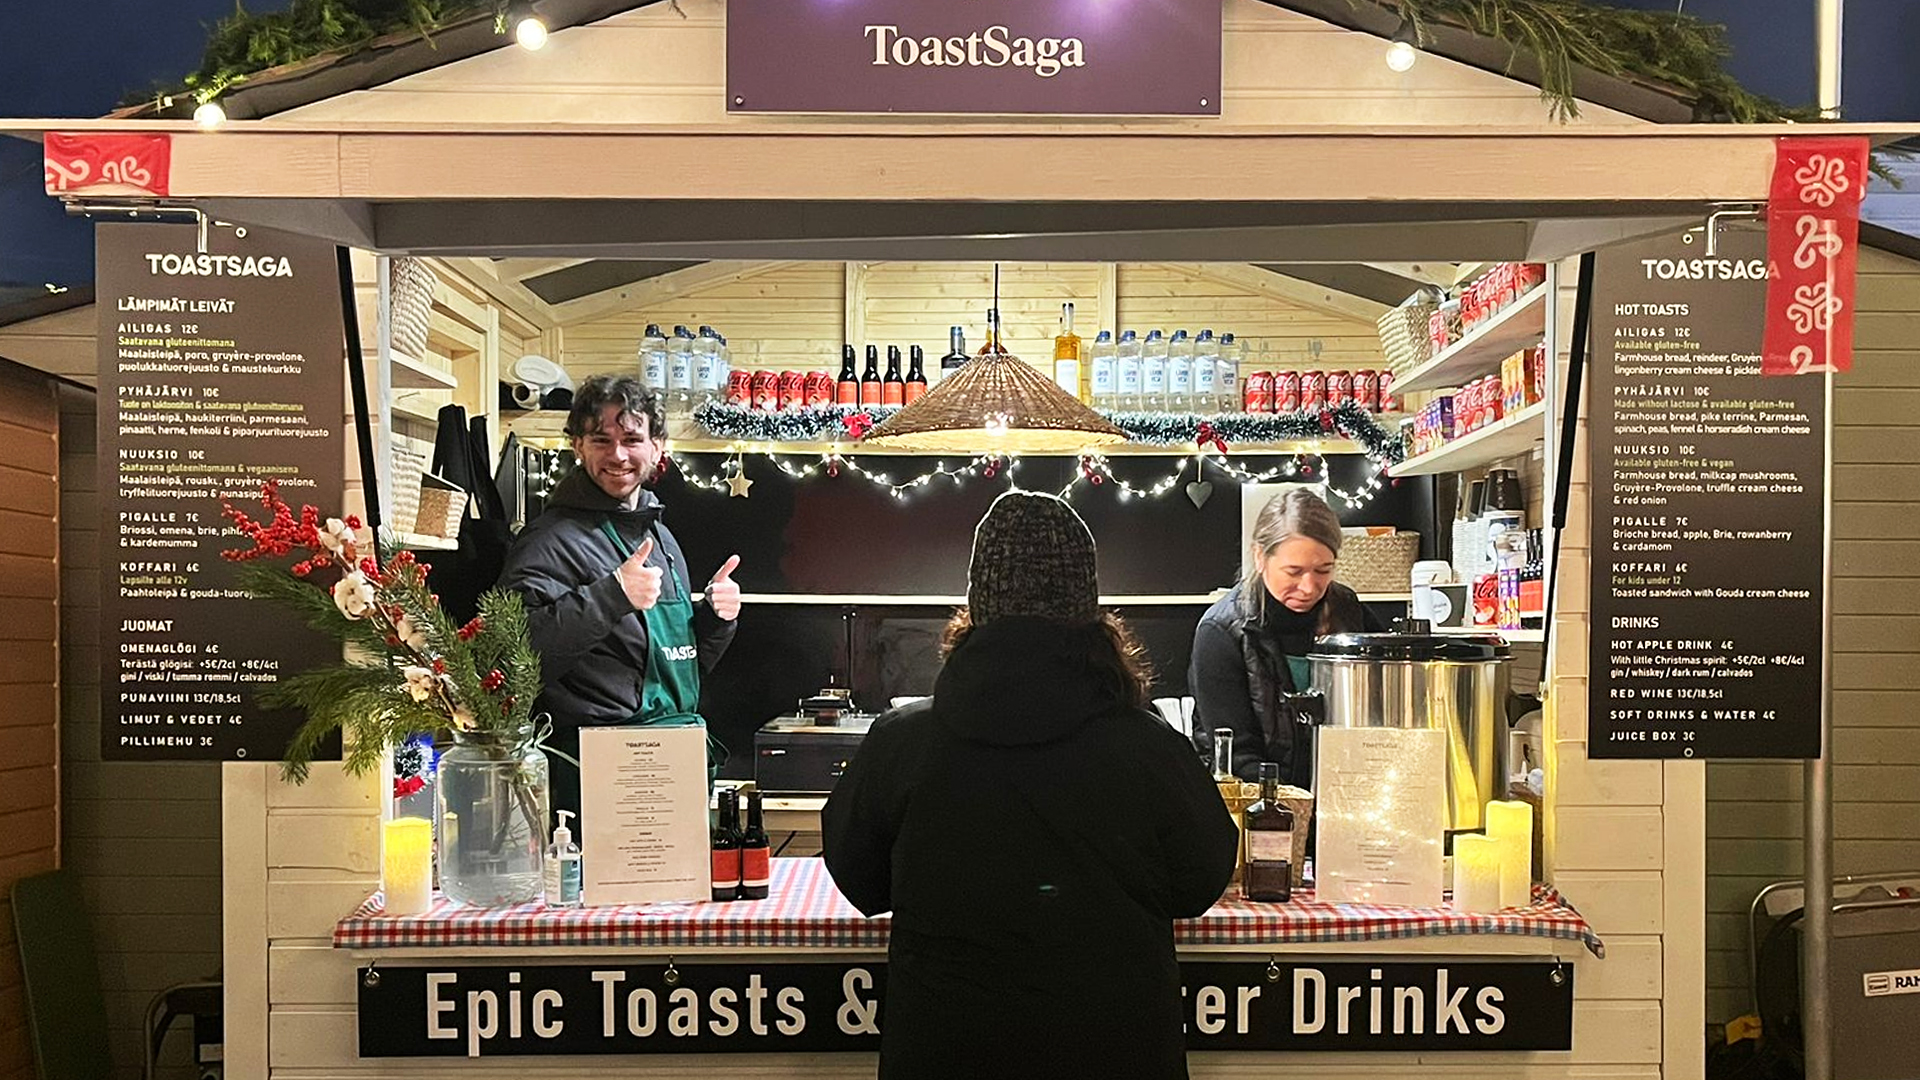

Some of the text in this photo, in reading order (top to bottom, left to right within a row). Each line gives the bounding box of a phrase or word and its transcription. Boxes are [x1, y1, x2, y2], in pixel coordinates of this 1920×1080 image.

[864, 25, 1085, 77] ToastSaga
[146, 254, 293, 277] TOASTSAGA
[1641, 259, 1781, 279] TOASTSAGA
[119, 297, 236, 312] LÄMPIMÄT LEIVÄT
[1615, 304, 1689, 315] HOT TOASTS
[118, 323, 199, 333] AILIGAS 12€
[1615, 328, 1691, 337] AILIGAS 12€
[119, 349, 183, 361] Maalaisleipä,
[185, 352, 211, 361] poro,
[1665, 353, 1692, 362] bread,
[1693, 353, 1731, 363] reindeer,
[119, 362, 302, 374] puolukkatuorejuusto maustekurkku
[1694, 366, 1724, 374] cheese
[119, 386, 220, 397] PYHÄJÄRVI 10€
[1615, 385, 1710, 396] PYHÄJÄRVI 10€
[120, 412, 309, 425] Maalaisleipä, haukiterriini, parmesaani,
[1615, 411, 1810, 422] Farmhouse bread, pike terrine, Parmesan,
[120, 426, 157, 435] pinaatti,
[158, 426, 189, 435] herne,
[233, 427, 330, 438] piparjuurituorejuusto
[120, 449, 205, 459] NUUKSIO 10€
[1614, 446, 1695, 454] NUUKSIO 10€
[1614, 471, 1798, 481] Farmhouse bread, milkcap mushrooms,
[120, 476, 184, 487] Maalaisleipä,
[1707, 483, 1736, 492] truffle
[1770, 484, 1804, 492] cheese
[120, 488, 209, 499] tryffelituorejuusto
[1623, 496, 1667, 504] red onion
[120, 512, 199, 522] PIGALLE 7€
[1614, 517, 1688, 526] PIGALLE 7€
[120, 525, 158, 535] Briossi,
[198, 526, 220, 536] brie,
[1613, 529, 1792, 540] Brioche bread, apple, Brie, rowanberry
[130, 538, 198, 547] kardemumma
[121, 563, 199, 572] KOFFARI 6€
[1613, 563, 1688, 572] KOFFARI 6€
[121, 588, 178, 598] Paahtoleipä
[1612, 588, 1647, 597] Toasted
[1649, 589, 1693, 597] sandwich
[1716, 588, 1745, 597] Gouda
[1777, 589, 1810, 597] cheese
[121, 620, 174, 631] JUOMAT
[1612, 617, 1659, 628] DRINKS
[121, 643, 219, 653] OMENAGLÖGI 4€
[1612, 641, 1734, 649] HOT APPLE DRINK 4€
[121, 659, 158, 668] Terästä
[1611, 656, 1632, 664] With
[1633, 656, 1653, 664] little
[1655, 656, 1701, 664] Christmas
[121, 672, 277, 682] gini calvados
[1611, 669, 1624, 678] gin
[1632, 668, 1665, 679] whiskey
[1672, 668, 1691, 676] dark
[1717, 668, 1754, 677] calvados
[121, 693, 190, 702] PUNAVIINI
[1611, 689, 1635, 698] RED
[1641, 689, 1673, 698] WINE
[121, 715, 242, 724] LIMUT VEDET 4€
[1611, 710, 1776, 719] SOFT DRINKS WATER 4€
[121, 737, 213, 745] PILLIMEHU 3€
[1610, 732, 1695, 740] JUICE BOX 3€
[426, 972, 565, 1058] Epic
[591, 969, 806, 1038] Toasts
[836, 968, 880, 1034] &
[1292, 968, 1506, 1035] Drinks
